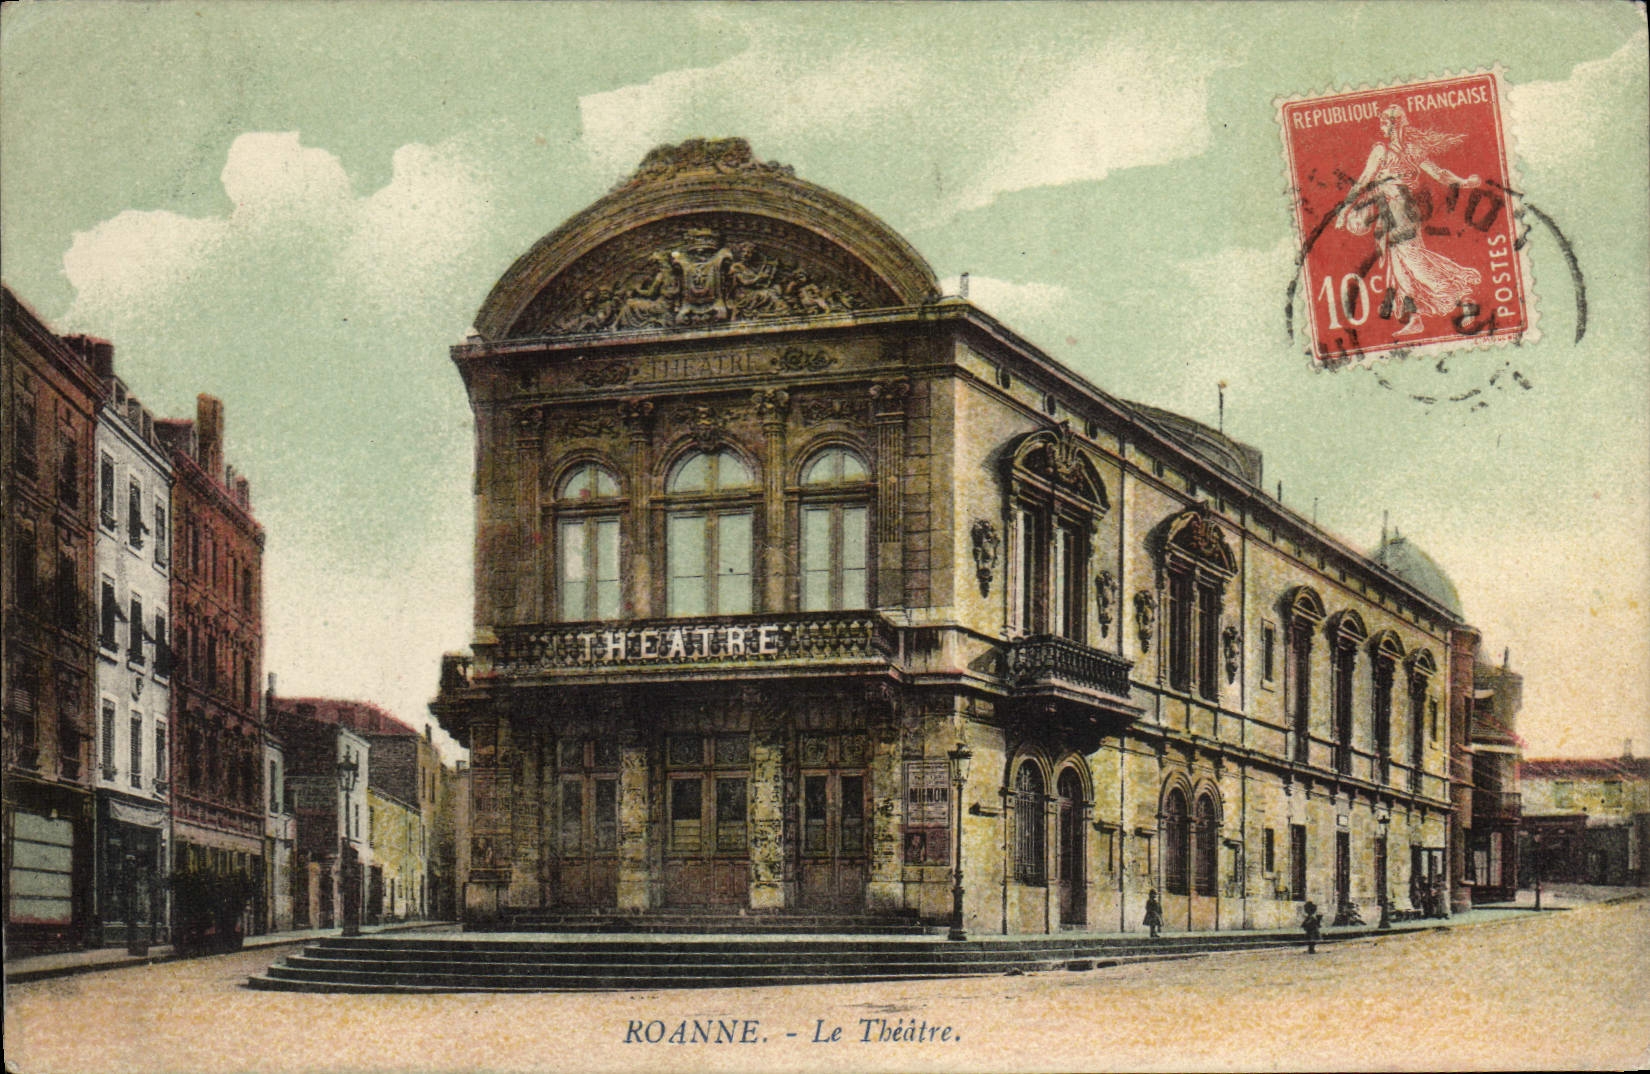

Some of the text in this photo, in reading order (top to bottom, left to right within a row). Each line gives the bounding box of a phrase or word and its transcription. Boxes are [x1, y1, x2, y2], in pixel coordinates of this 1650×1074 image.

[1407, 85, 1488, 113] FRANÇAISE
[1488, 233, 1516, 318] POSTES
[577, 626, 779, 661] THEATRE
